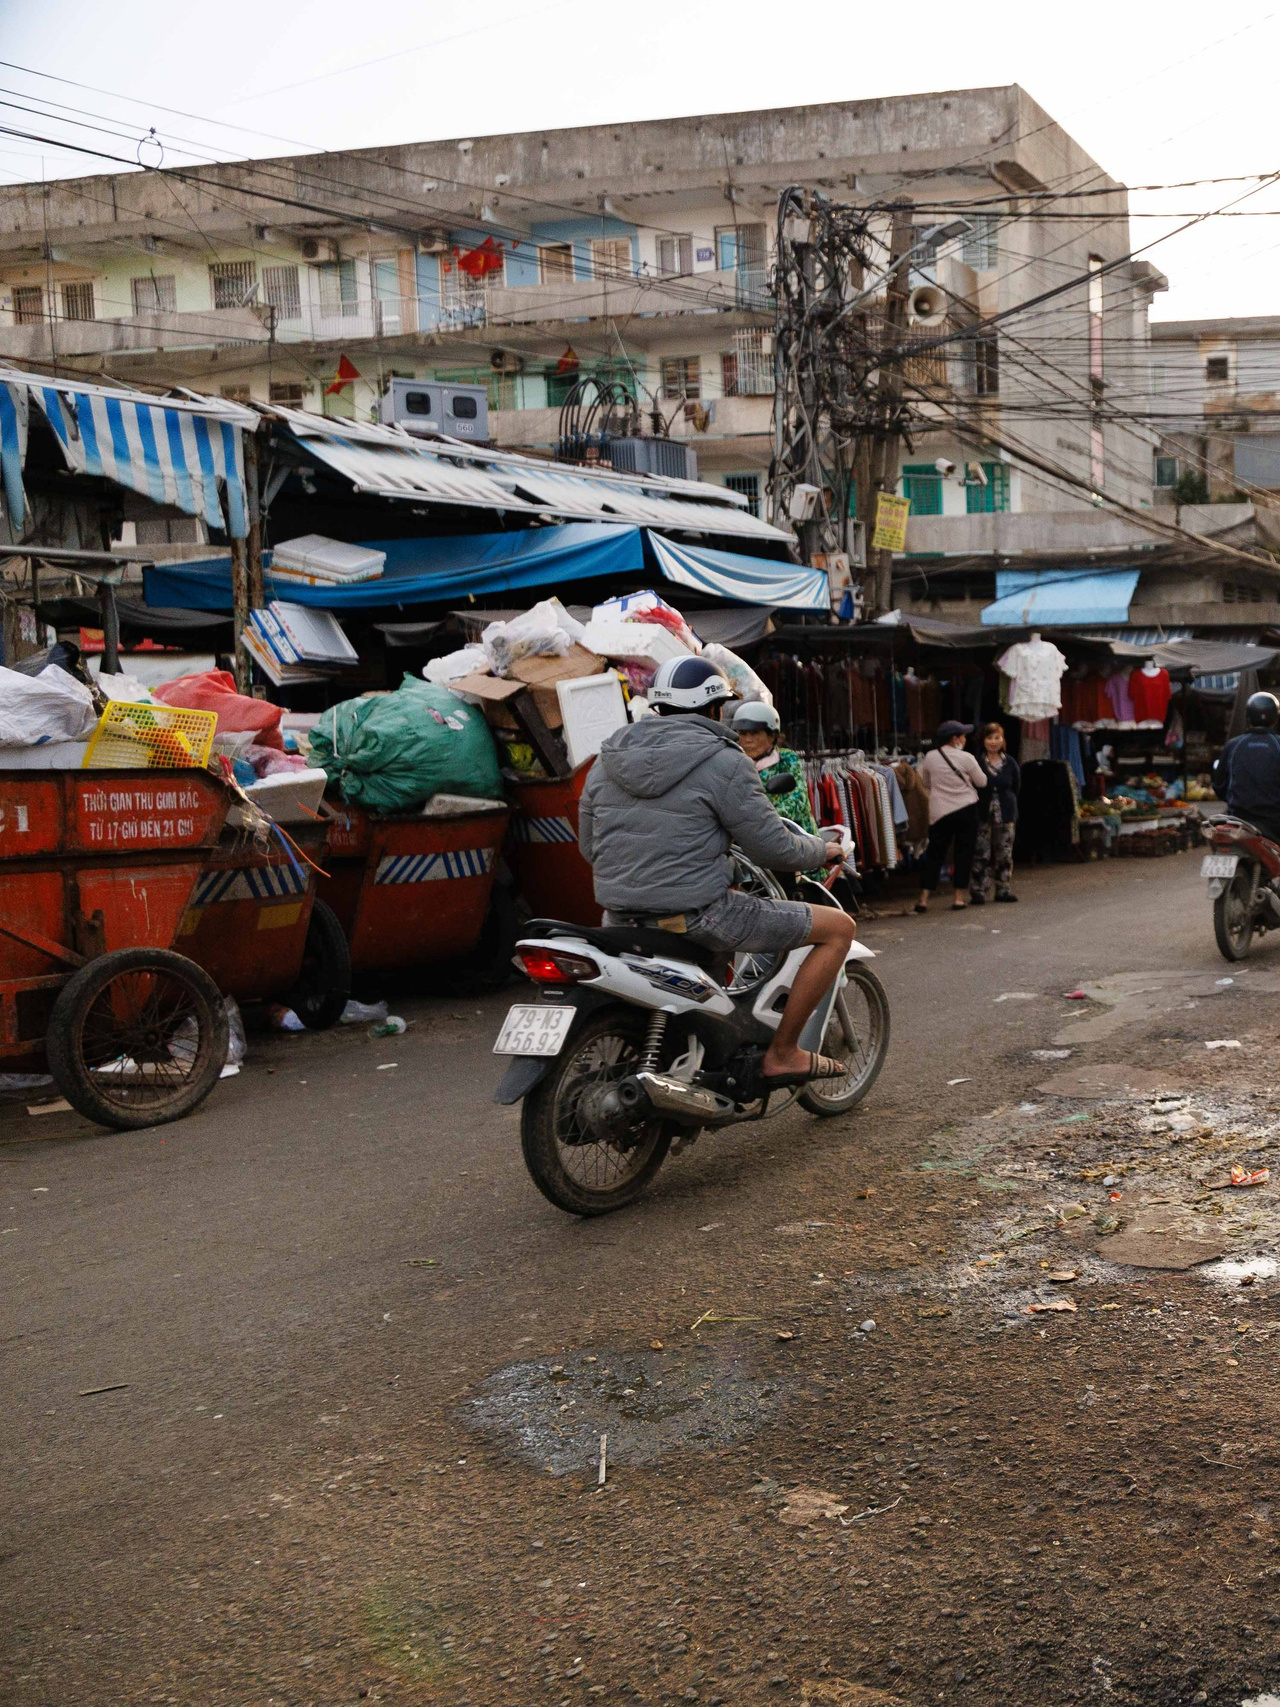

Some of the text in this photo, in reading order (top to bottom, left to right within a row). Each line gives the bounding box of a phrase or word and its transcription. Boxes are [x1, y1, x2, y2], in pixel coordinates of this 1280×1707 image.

[83, 785, 199, 812] THỜI GIAN THU GOM RÁC
[107, 821, 119, 841] 17
[163, 819, 174, 838] 21
[513, 1009, 564, 1030] 79-N3
[503, 1031, 561, 1053] 156.92
